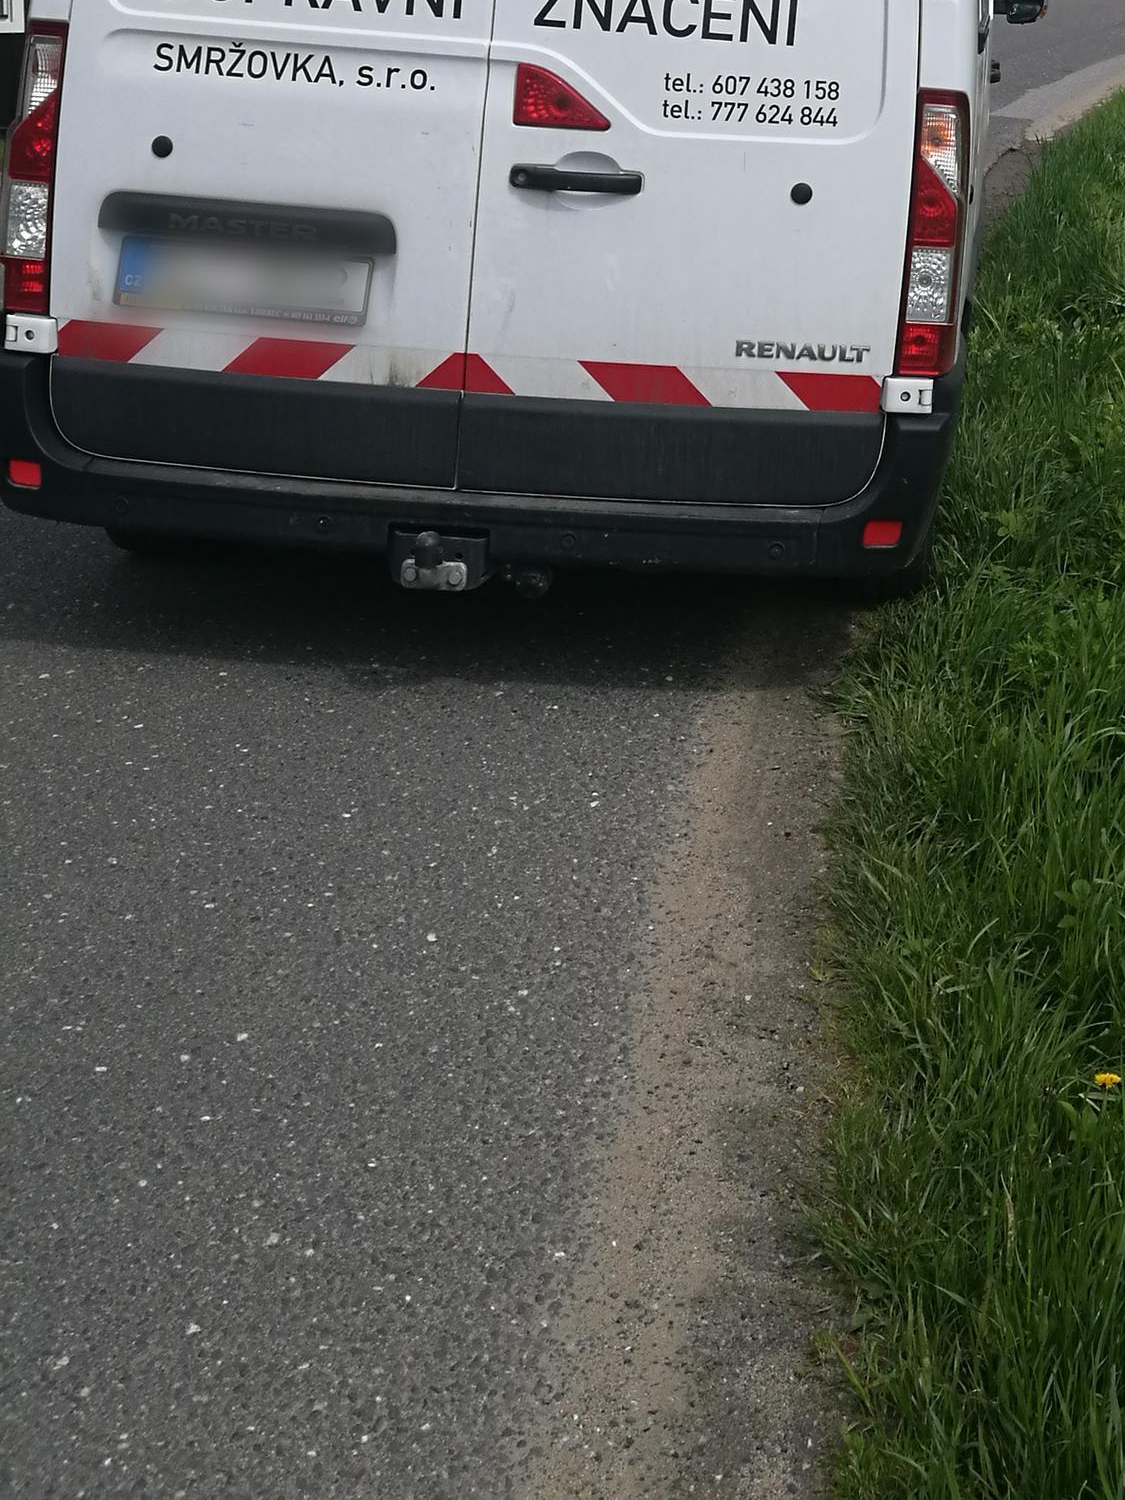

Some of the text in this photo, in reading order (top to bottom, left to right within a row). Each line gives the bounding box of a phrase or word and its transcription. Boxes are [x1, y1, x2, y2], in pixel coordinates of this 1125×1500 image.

[153, 41, 436, 91] SMRŽOVKA, s.r.o.
[664, 73, 840, 100] tel.: 607 438 158
[662, 100, 838, 127] tel.: 777 624 844
[168, 212, 318, 240] MASTER
[124, 273, 143, 286] CZ
[735, 340, 870, 363] RENAULT
